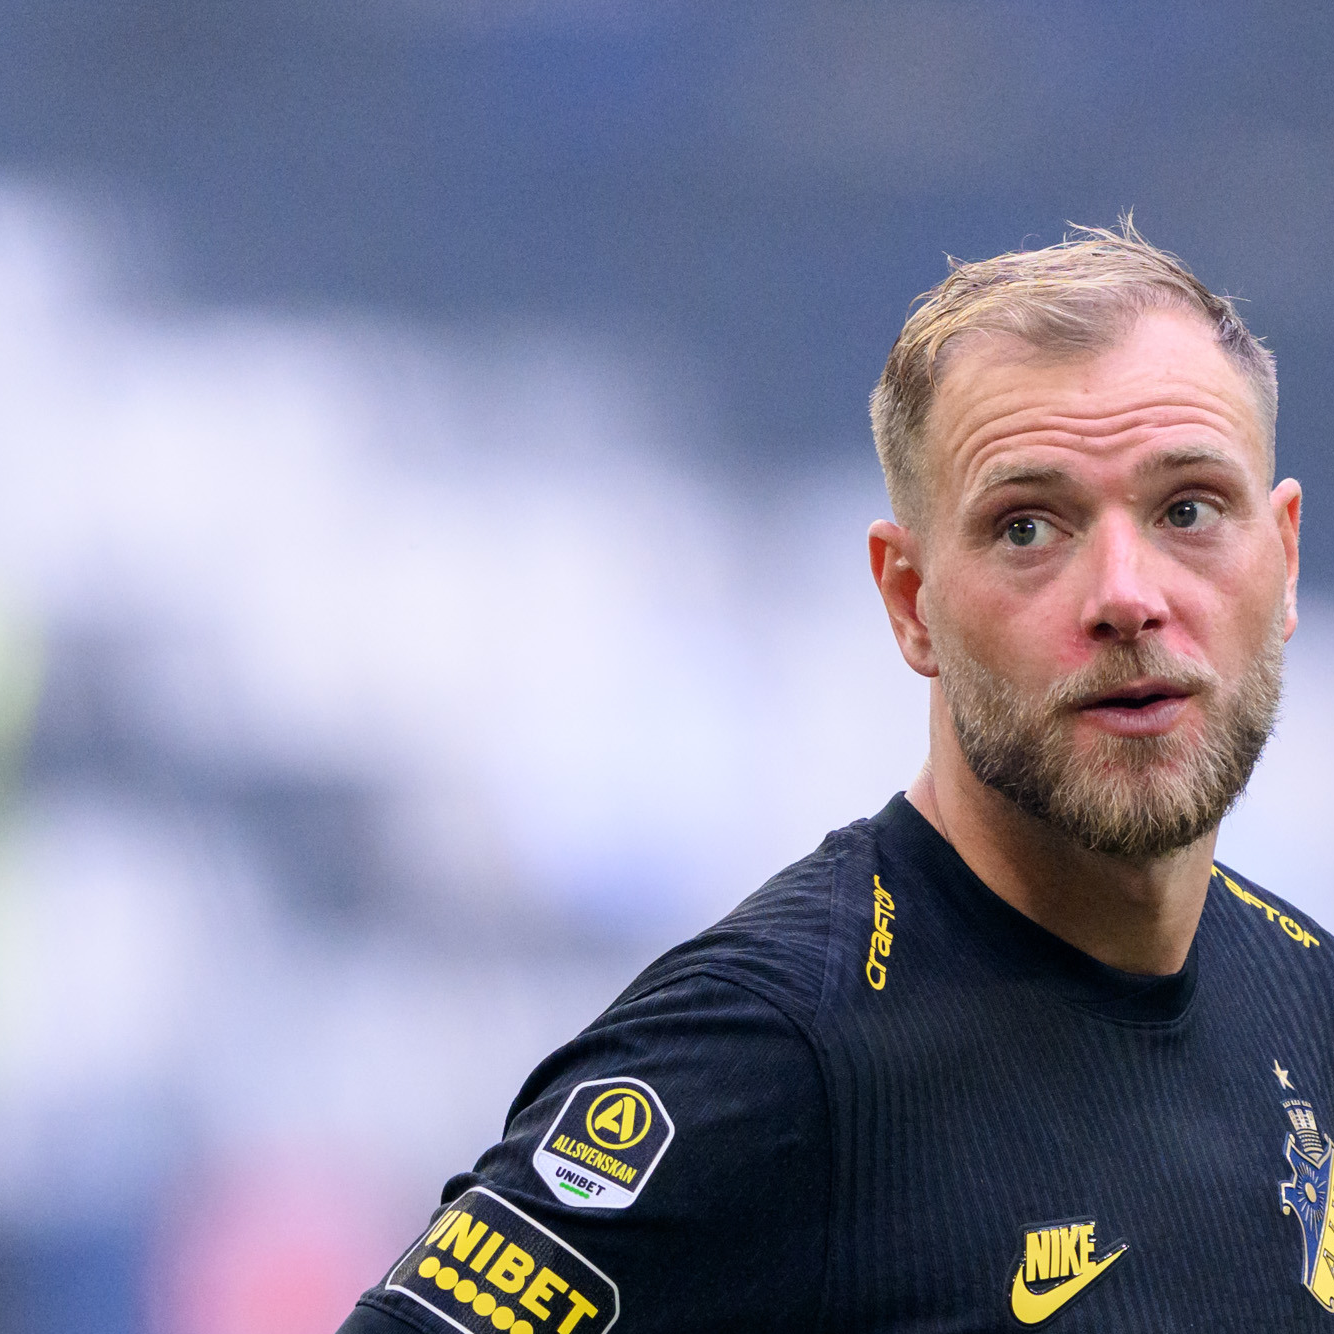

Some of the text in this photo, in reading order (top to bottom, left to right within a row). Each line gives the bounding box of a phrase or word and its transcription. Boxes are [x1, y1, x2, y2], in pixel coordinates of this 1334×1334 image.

[552, 1134, 637, 1184] ALLSVENSKAN
[555, 1166, 606, 1196] UNIBET
[1025, 1223, 1097, 1283] NIKE
